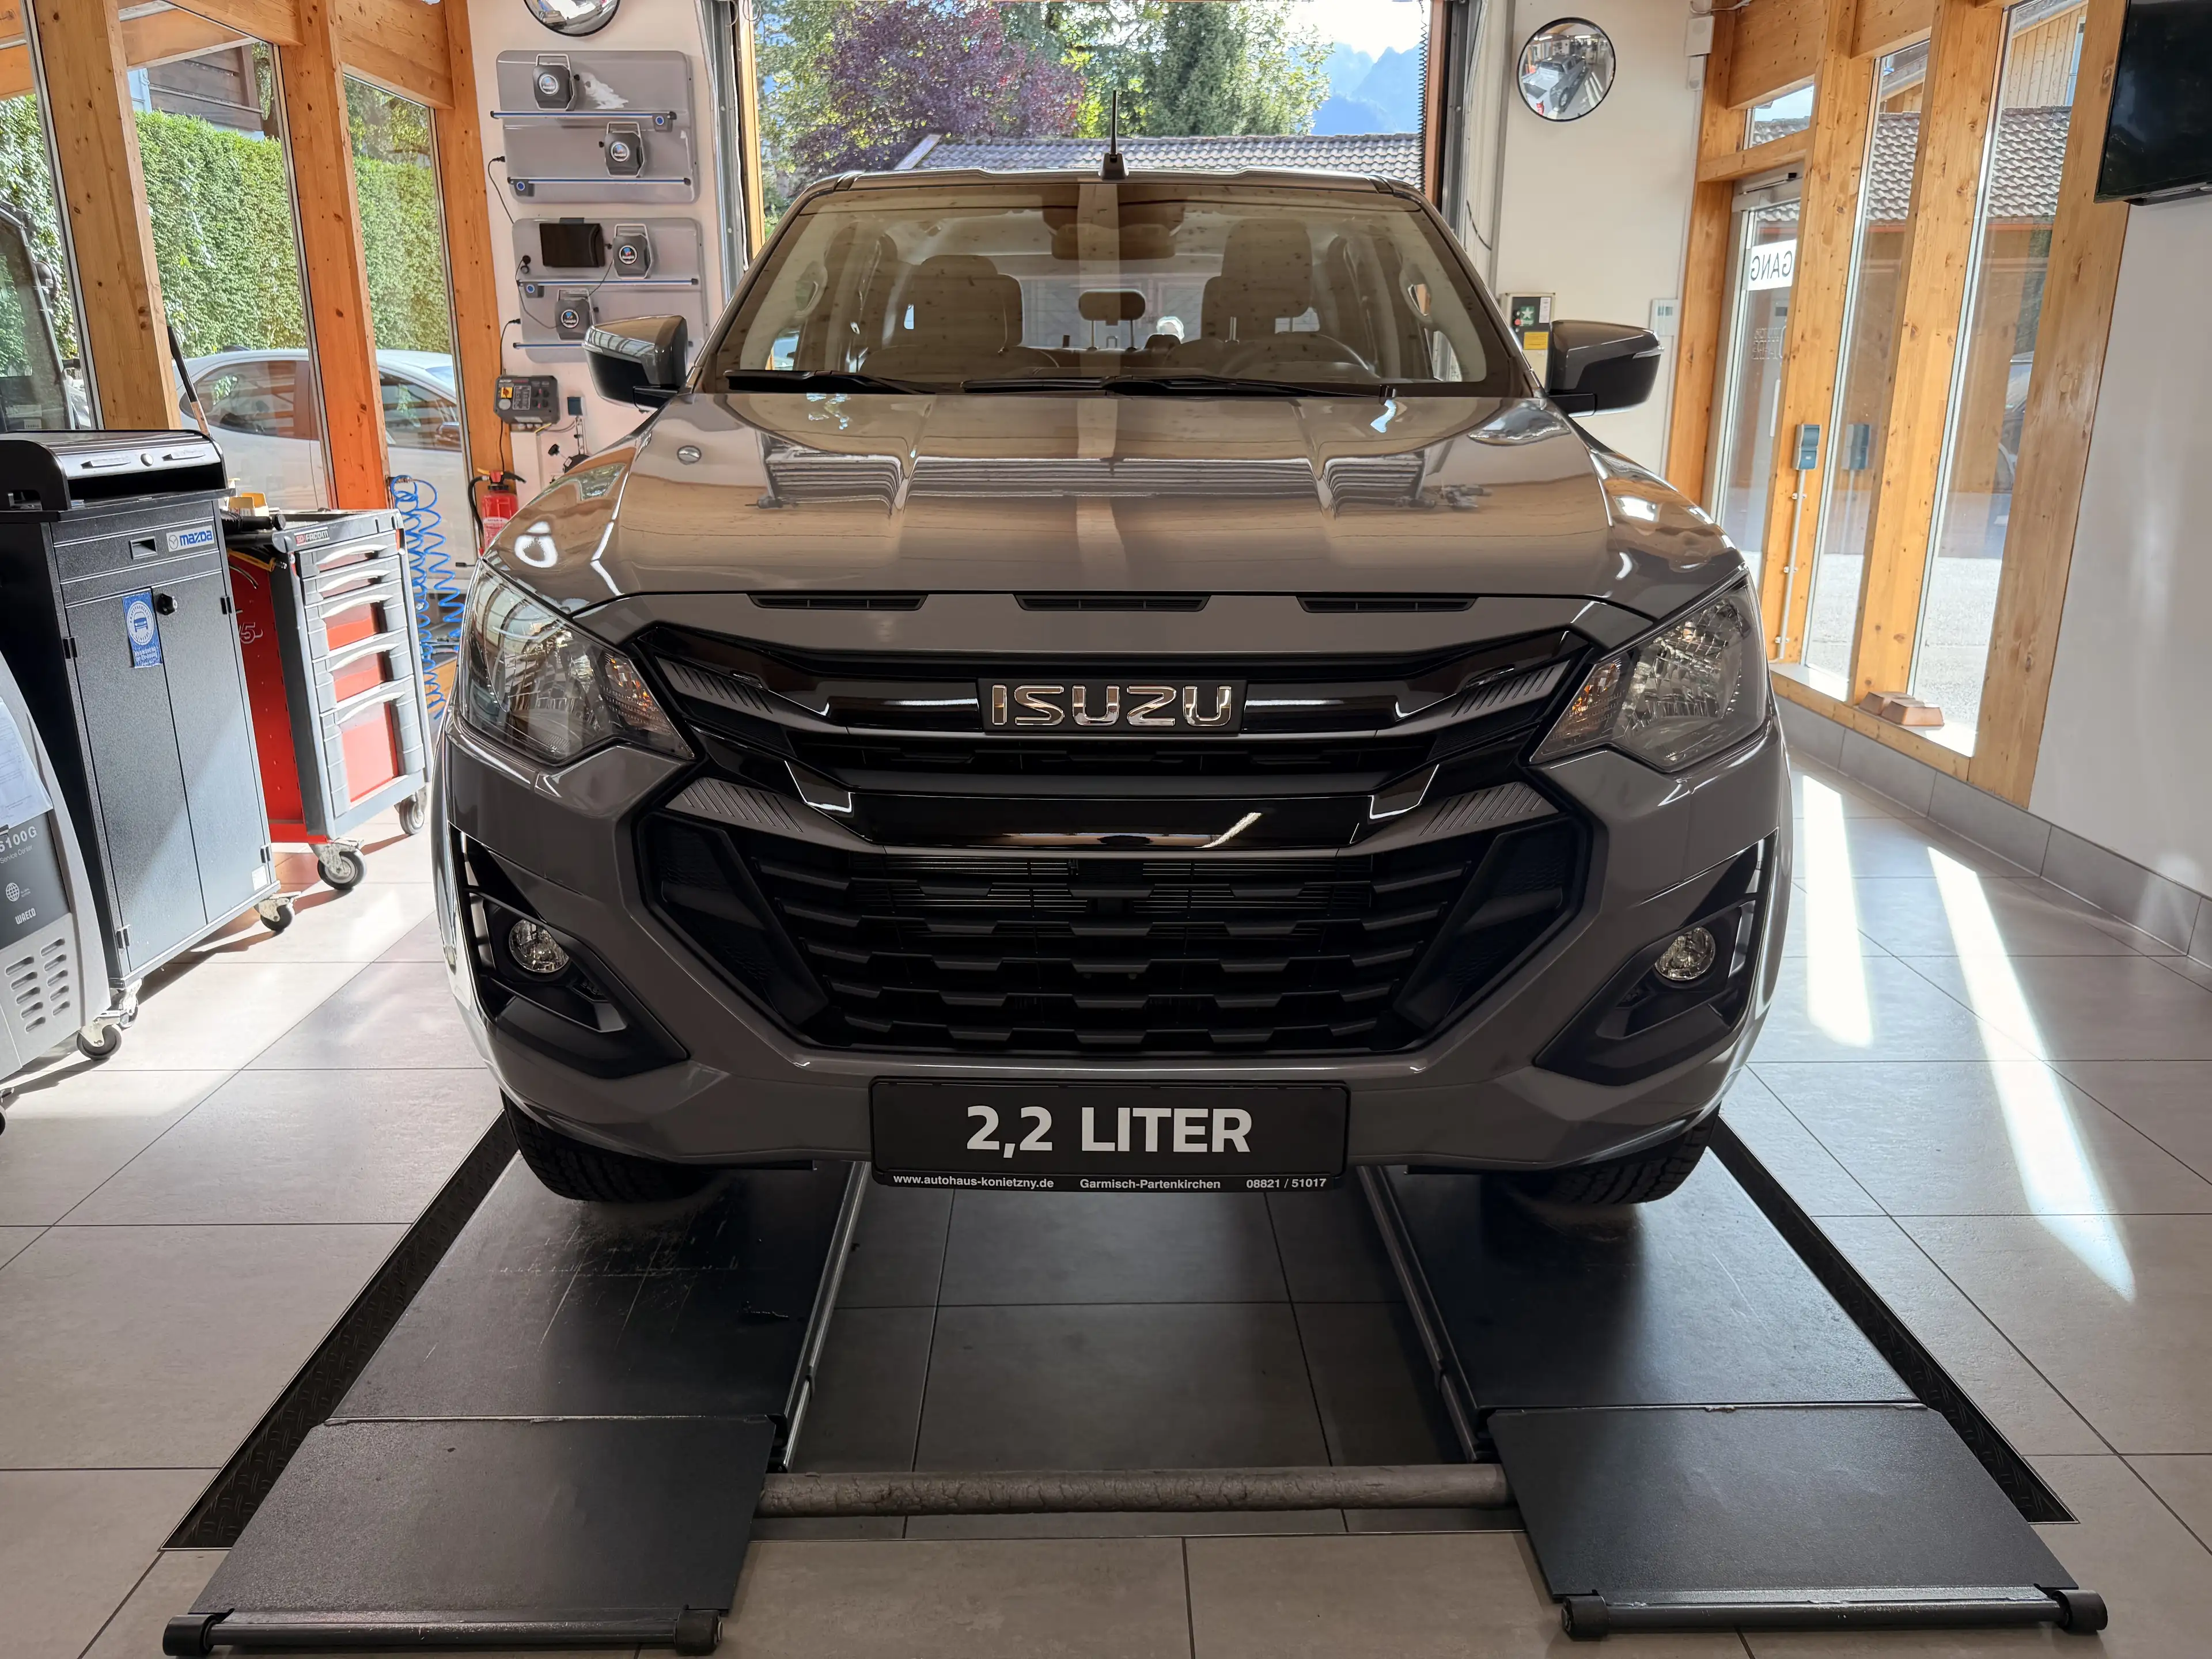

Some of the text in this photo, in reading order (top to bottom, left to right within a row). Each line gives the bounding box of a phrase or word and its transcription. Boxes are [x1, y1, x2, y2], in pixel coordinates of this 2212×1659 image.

[991, 684, 1232, 728] ISUZU
[15, 908, 36, 925] WAECO
[967, 1105, 1252, 1158] 2,2 LITER
[893, 1175, 1327, 1190] www.autohaus-konietzny.de Garmisch-Partenkirchen 08821 / 51017
